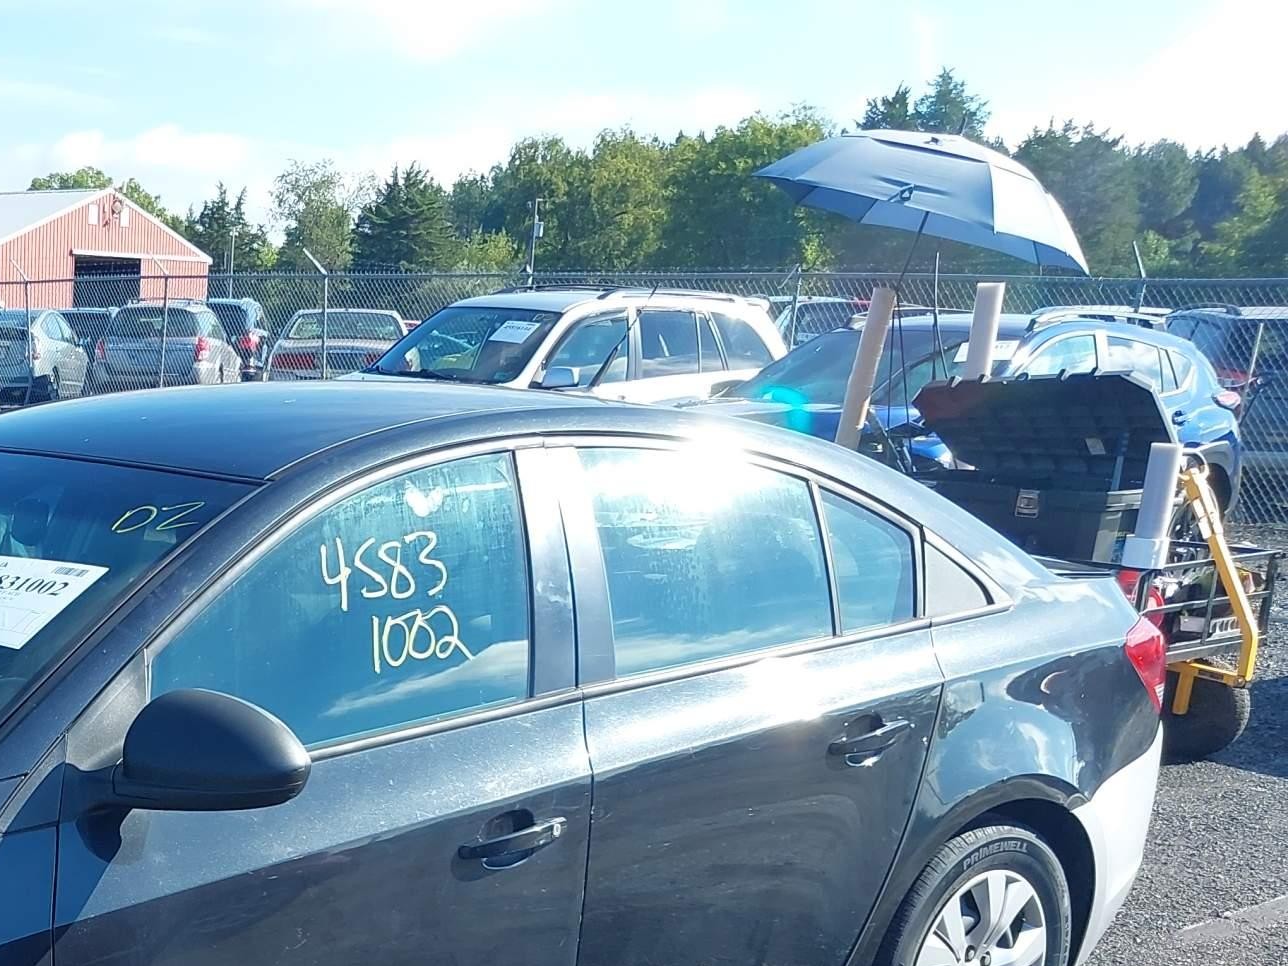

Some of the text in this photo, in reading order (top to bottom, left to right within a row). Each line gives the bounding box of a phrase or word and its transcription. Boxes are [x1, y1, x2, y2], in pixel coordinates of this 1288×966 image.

[319, 530, 448, 611] 4583
[371, 604, 474, 674] 1002
[963, 840, 1028, 871] PRIMEWELL
